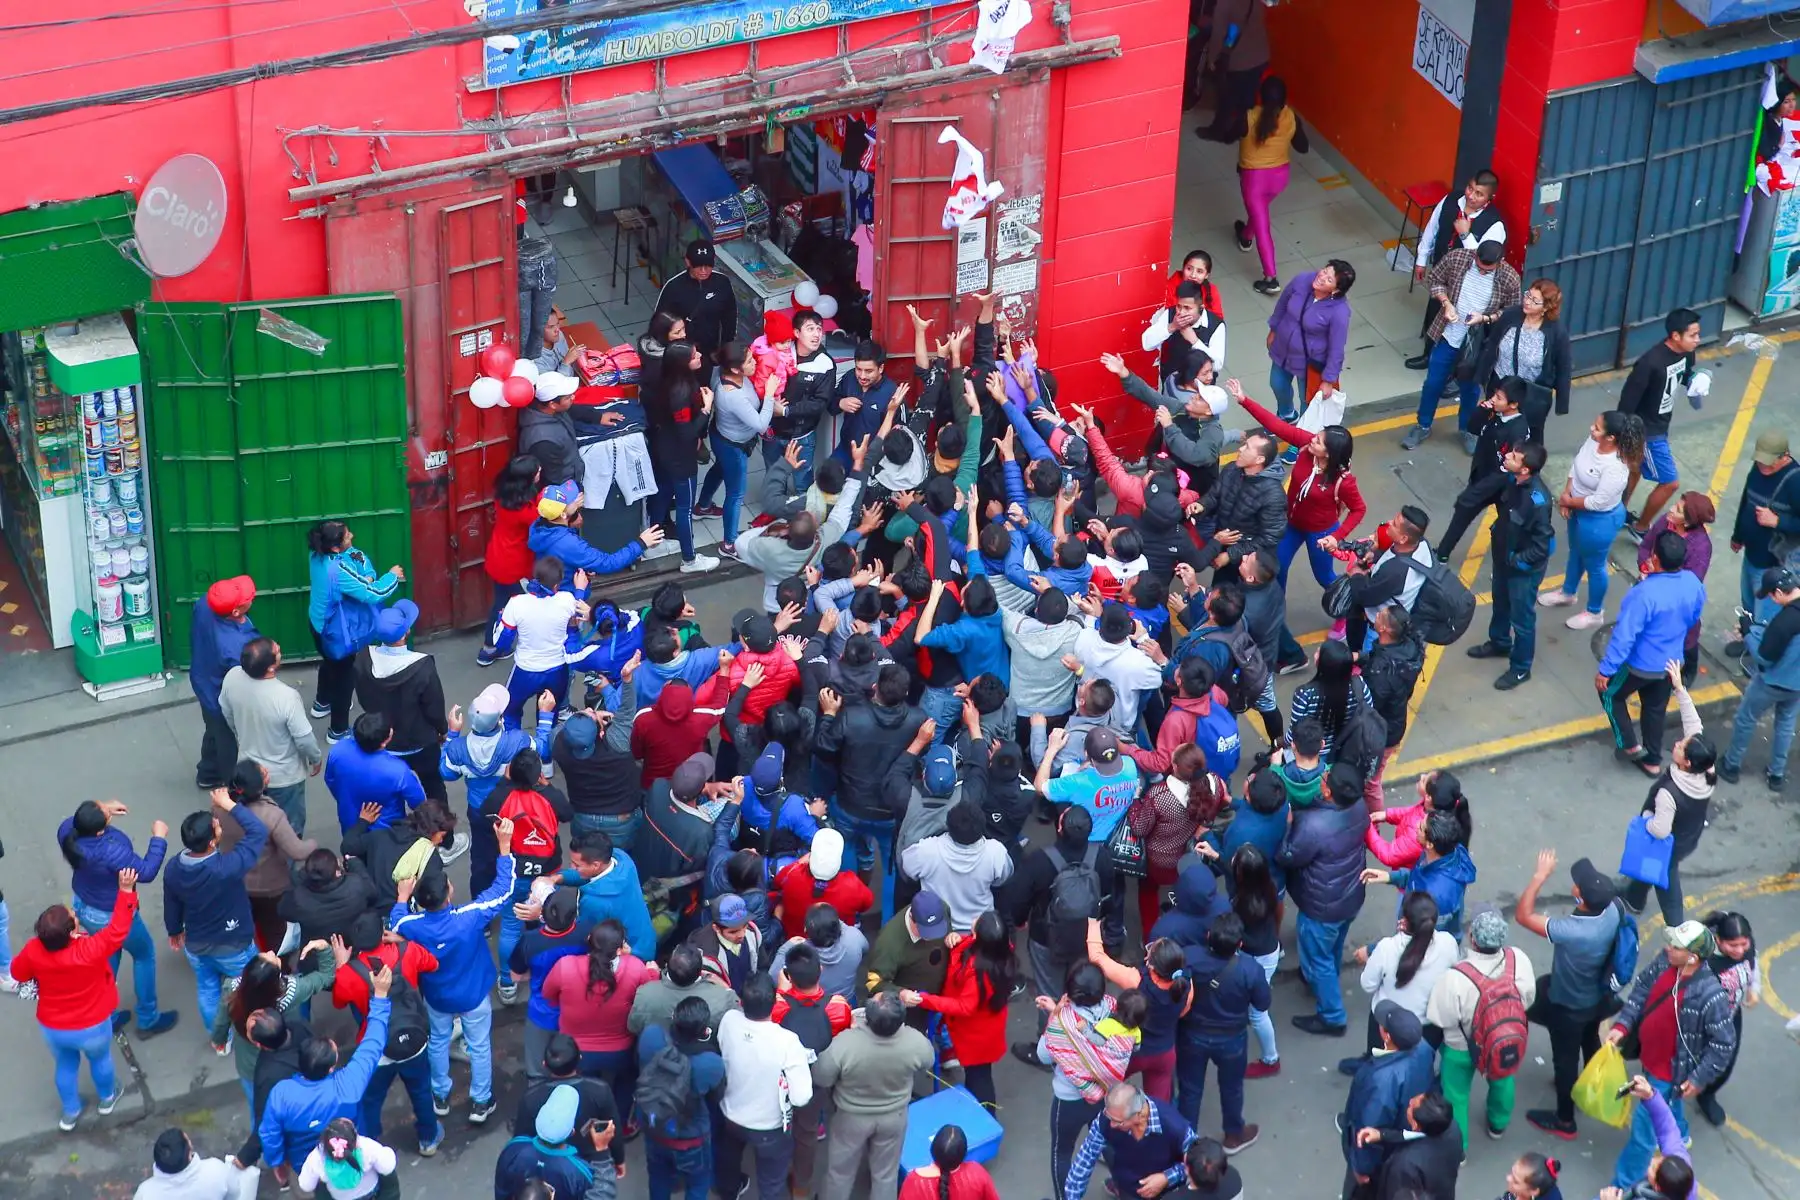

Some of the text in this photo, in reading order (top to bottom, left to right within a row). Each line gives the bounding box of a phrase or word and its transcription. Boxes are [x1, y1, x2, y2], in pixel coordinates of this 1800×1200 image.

[604, 18, 739, 64] HUMBOLDT
[744, 12, 764, 38] #
[772, 0, 832, 32] 1660
[1418, 10, 1432, 43] SE
[144, 186, 211, 238] Claro
[523, 861, 542, 875] 23
